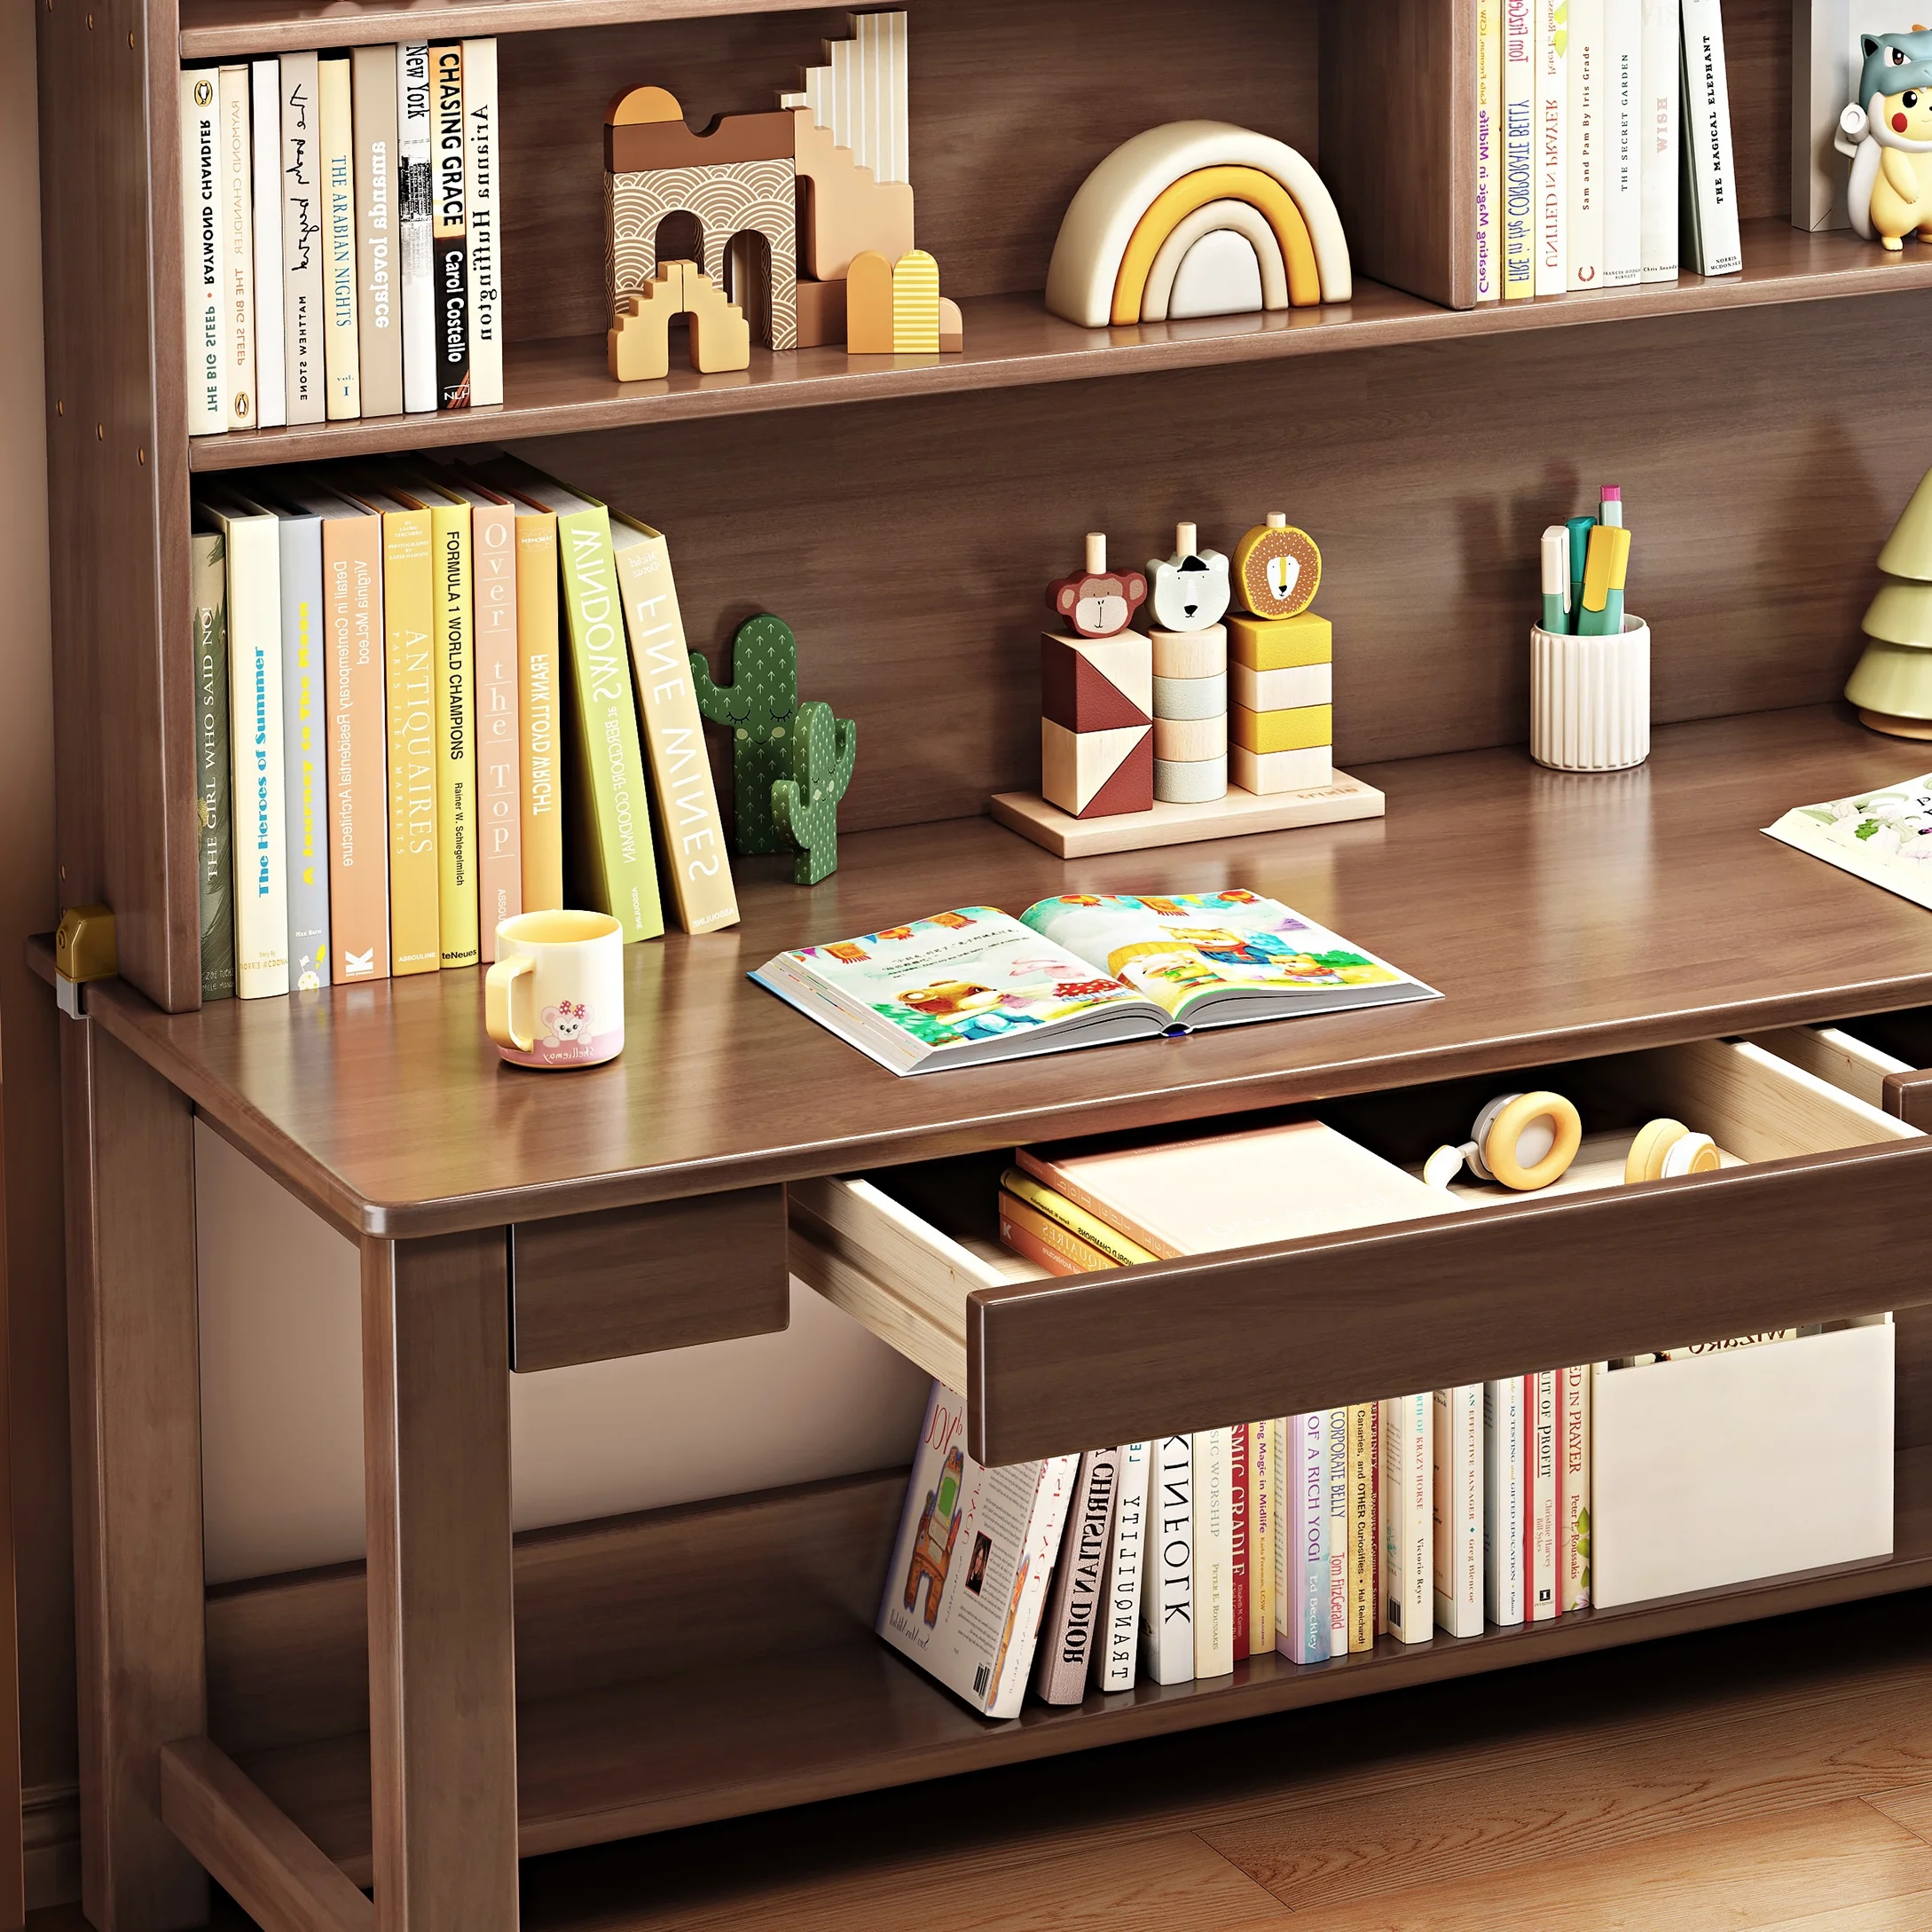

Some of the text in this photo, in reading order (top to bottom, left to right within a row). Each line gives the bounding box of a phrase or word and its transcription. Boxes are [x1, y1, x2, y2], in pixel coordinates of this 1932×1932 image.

[404, 43, 428, 78] New
[406, 85, 430, 120] York
[1582, 114, 1591, 127] By
[1656, 97, 1668, 153] WISH
[1702, 35, 1724, 205] THE MAGICAL ELEPHANT
[438, 52, 464, 226] CHASING GRACE
[331, 155, 352, 326] THE ARABIAN NIGHTS
[444, 249, 466, 363] Carol Costello
[483, 522, 508, 629] Over
[447, 531, 464, 760] FORMULA WORLD CHAMPIONS
[200, 606, 219, 881] THE GIRL WHO SAID NO!
[299, 601, 315, 885] A Journey to The Moon
[404, 630, 433, 854] ANTIQUAIRES
[254, 646, 270, 898] The Heroes of Summer
[395, 766, 404, 855] MARKETS
[453, 782, 465, 886] Rainer Schlegelmilch
[398, 951, 436, 963] ASSOULINE
[441, 948, 477, 960] teNeues
[1416, 1419, 1424, 1433] OF
[1469, 1392, 1475, 1407] AN
[1509, 1405, 1517, 1417] IQ
[1255, 1441, 1267, 1476] Magic
[1355, 1410, 1366, 1457] Canaries,
[1537, 1400, 1552, 1479] OF PROFIT
[1258, 1479, 1266, 1490] in
[1357, 1460, 1366, 1480] and
[1568, 1391, 1583, 1580] IN PRAYER Peter Roussakis
[1209, 1460, 1221, 1538] WORSHIP
[1258, 1494, 1268, 1534] Midlife
[1330, 1410, 1346, 1630] CORPORATE BELLY Tom FitzGerald
[1357, 1482, 1367, 1519] OTHER
[1308, 1415, 1321, 1650] OF A RICH YOGI Ed Beckley
[1357, 1520, 1367, 1575] Curiosities
[1416, 1537, 1425, 1575] Victorio
[1543, 1499, 1552, 1568] Christine Harvey
[1358, 1588, 1367, 1604] Hal
[1416, 1578, 1425, 1605] Reyes
